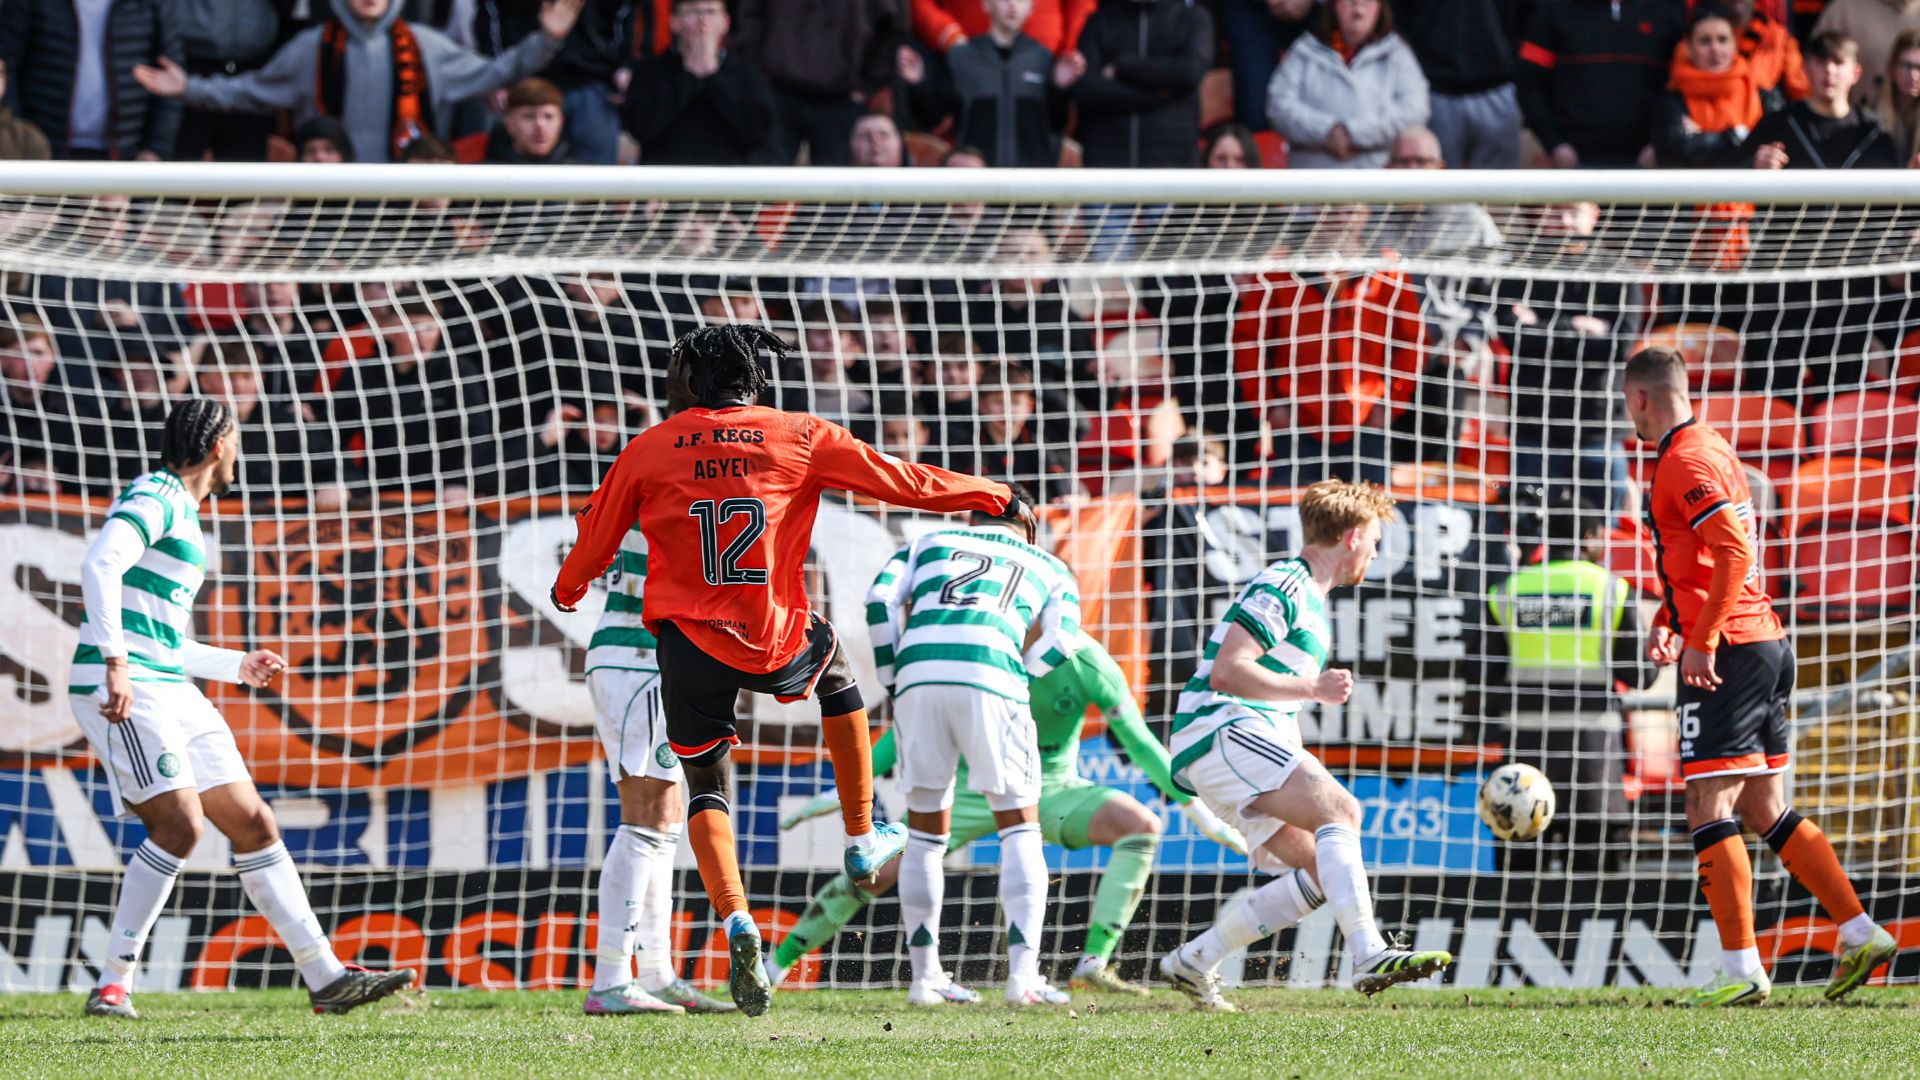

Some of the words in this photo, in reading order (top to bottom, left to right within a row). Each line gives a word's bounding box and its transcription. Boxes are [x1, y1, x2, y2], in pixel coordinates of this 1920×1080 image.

[673, 433, 706, 449] J.F.
[712, 428, 765, 444] KEGS
[694, 457, 749, 480] AGYEI
[688, 497, 768, 586] 12
[938, 549, 1026, 615] 21
[700, 618, 747, 631] NORMAN
